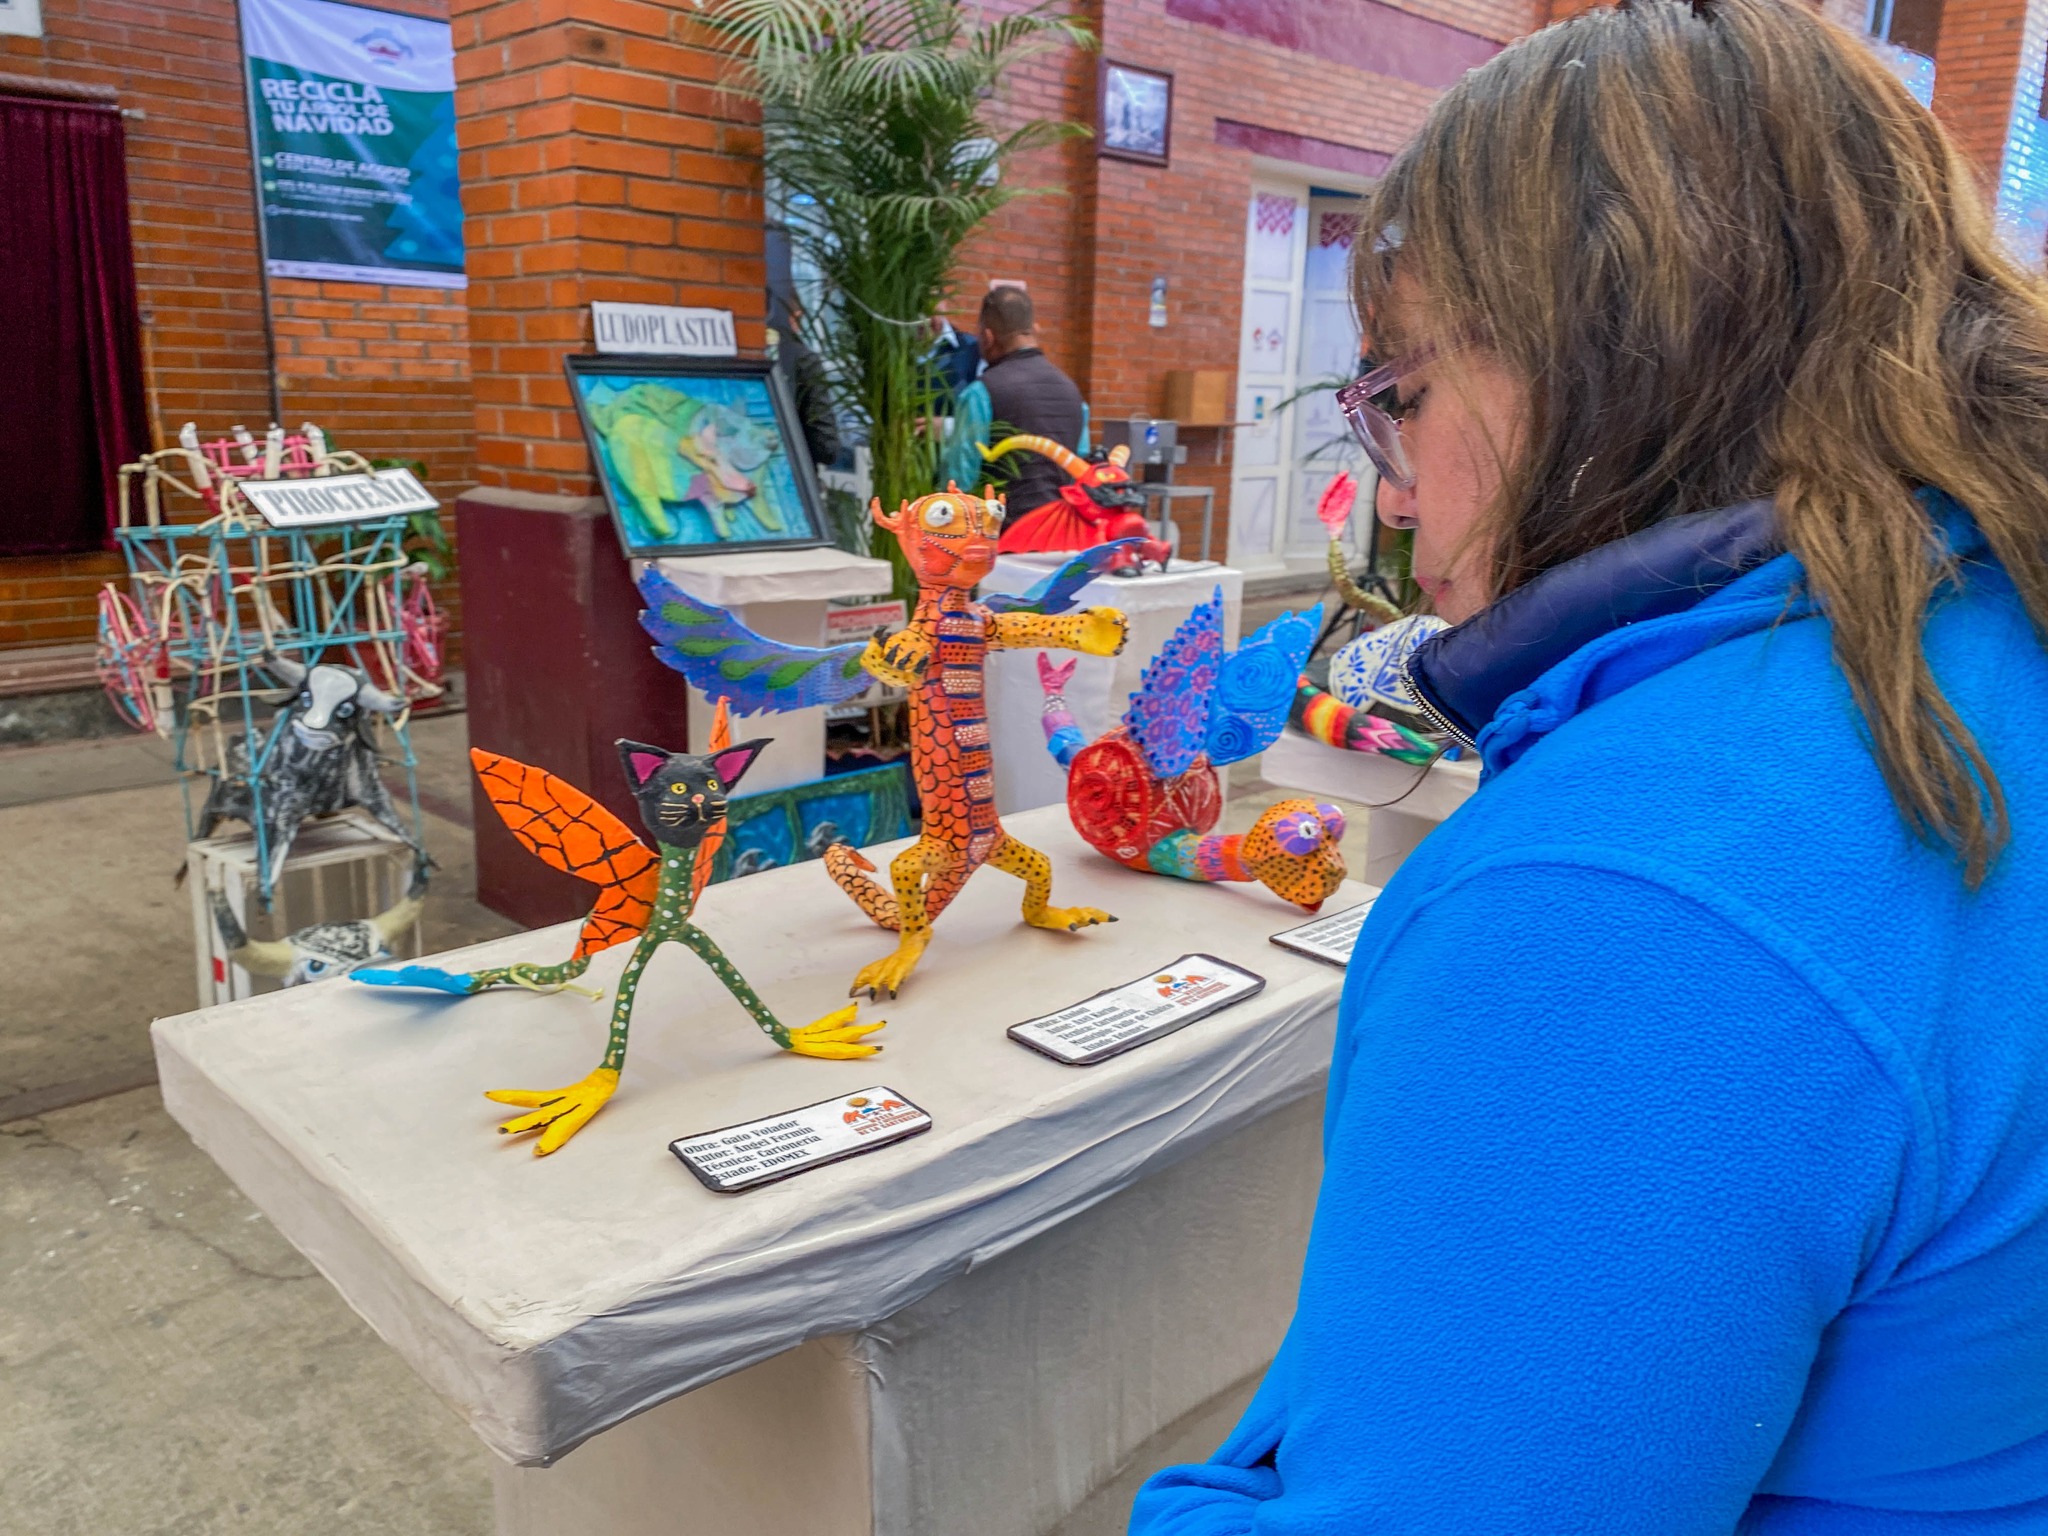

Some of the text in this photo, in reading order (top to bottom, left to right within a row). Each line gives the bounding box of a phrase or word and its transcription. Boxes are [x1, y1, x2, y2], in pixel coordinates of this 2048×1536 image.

[259, 78, 384, 104] RECICLA
[267, 99, 295, 114] TU
[363, 103, 392, 118] DE
[272, 114, 395, 136] NAVIDAD
[598, 312, 736, 347] LUDOPLASTIA
[1045, 1022, 1075, 1034] Autor:
[1081, 1038, 1116, 1051] Estado:
[683, 1119, 800, 1155] Obra: Gato Volador
[693, 1149, 734, 1164] Autor:
[701, 1135, 822, 1172] Técnica: Cartonería
[712, 1149, 810, 1181] Estado: EDOMEX
